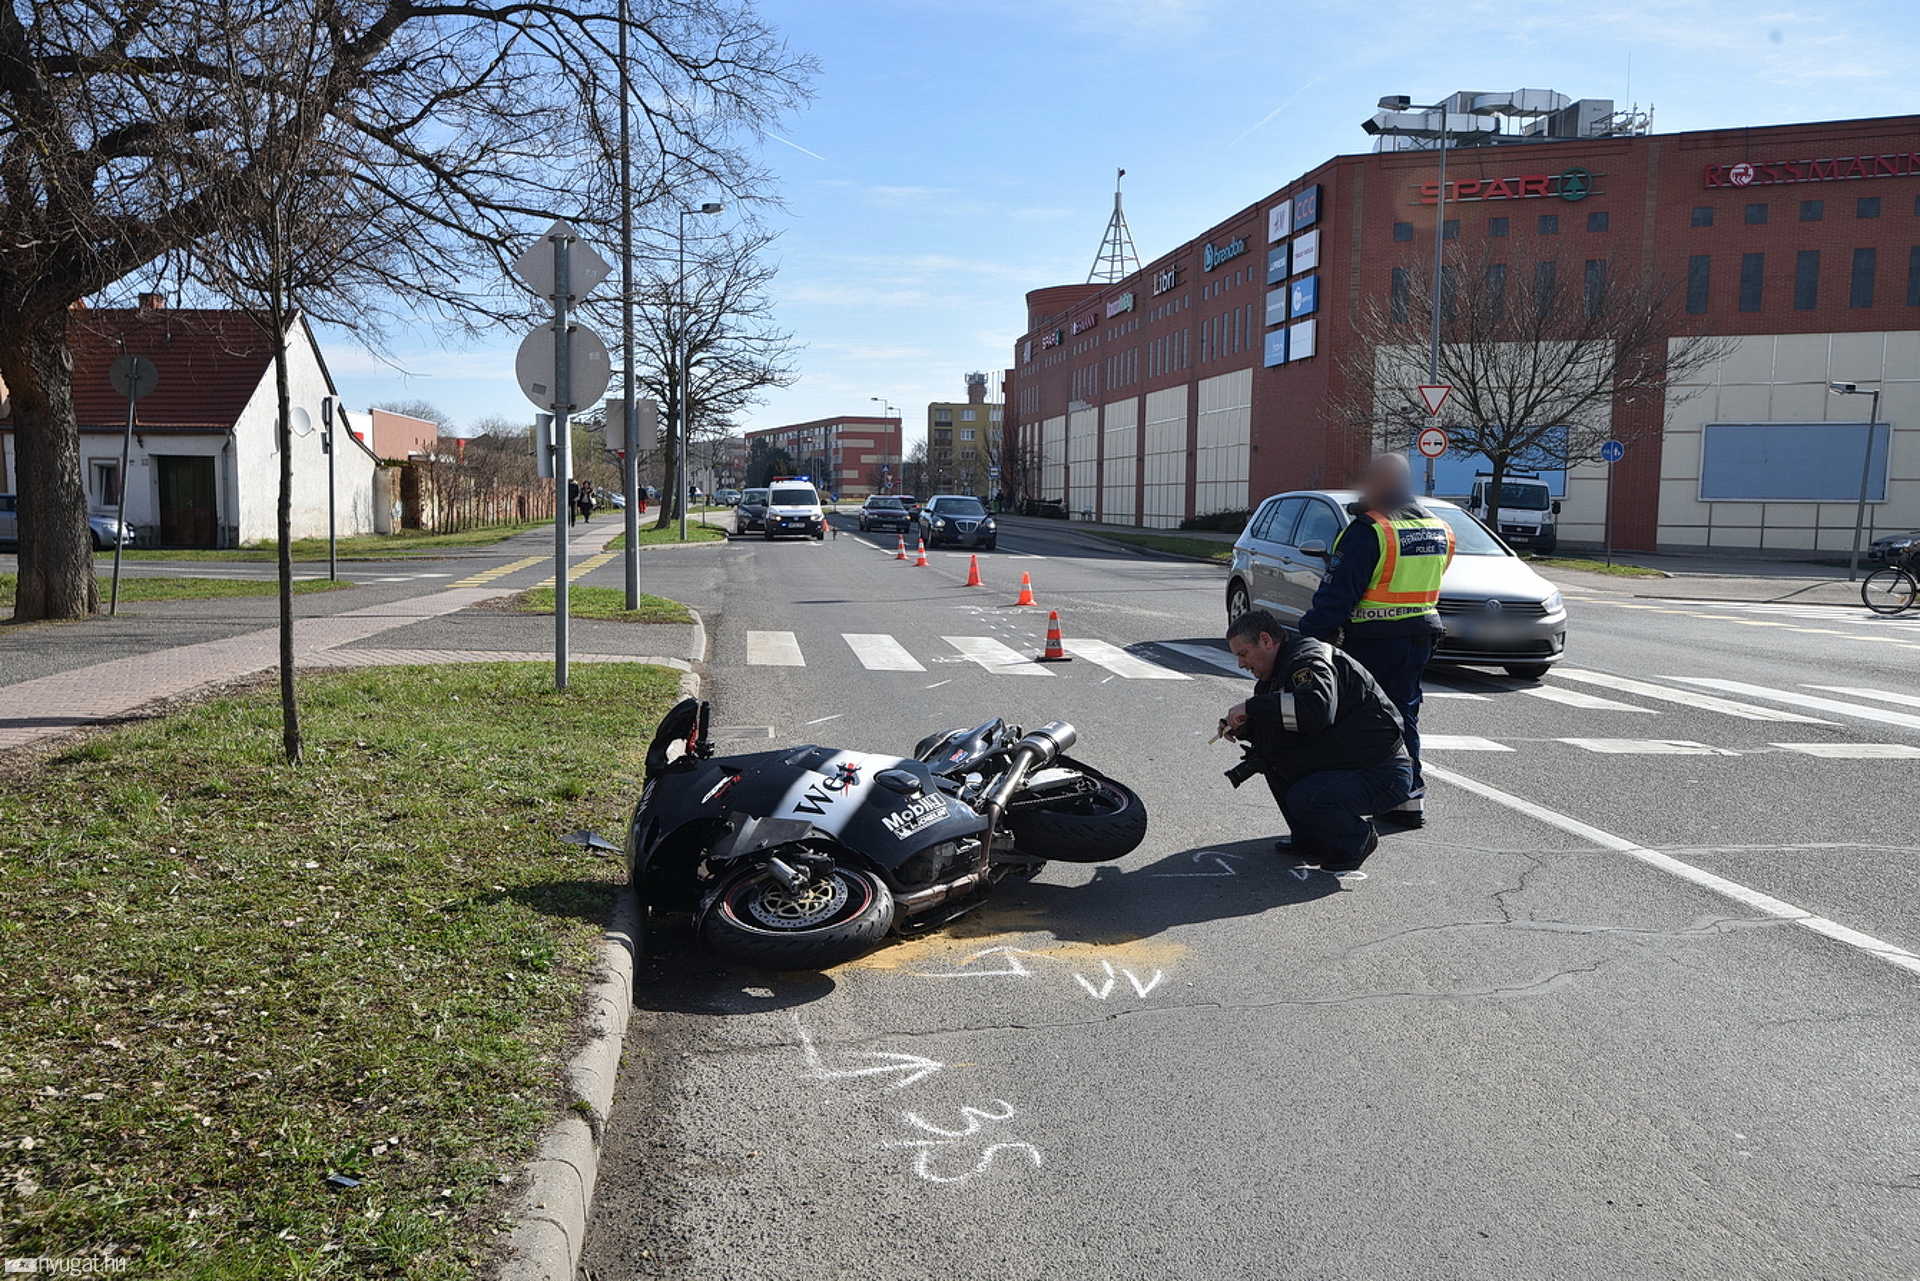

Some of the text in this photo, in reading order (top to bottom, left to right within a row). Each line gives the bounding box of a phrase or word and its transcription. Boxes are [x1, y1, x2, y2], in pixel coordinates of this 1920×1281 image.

[1420, 175, 1550, 203] SPAR
[1153, 264, 1176, 296] Libri
[1415, 545, 1436, 553] POLICE
[881, 797, 933, 833] Mobil
